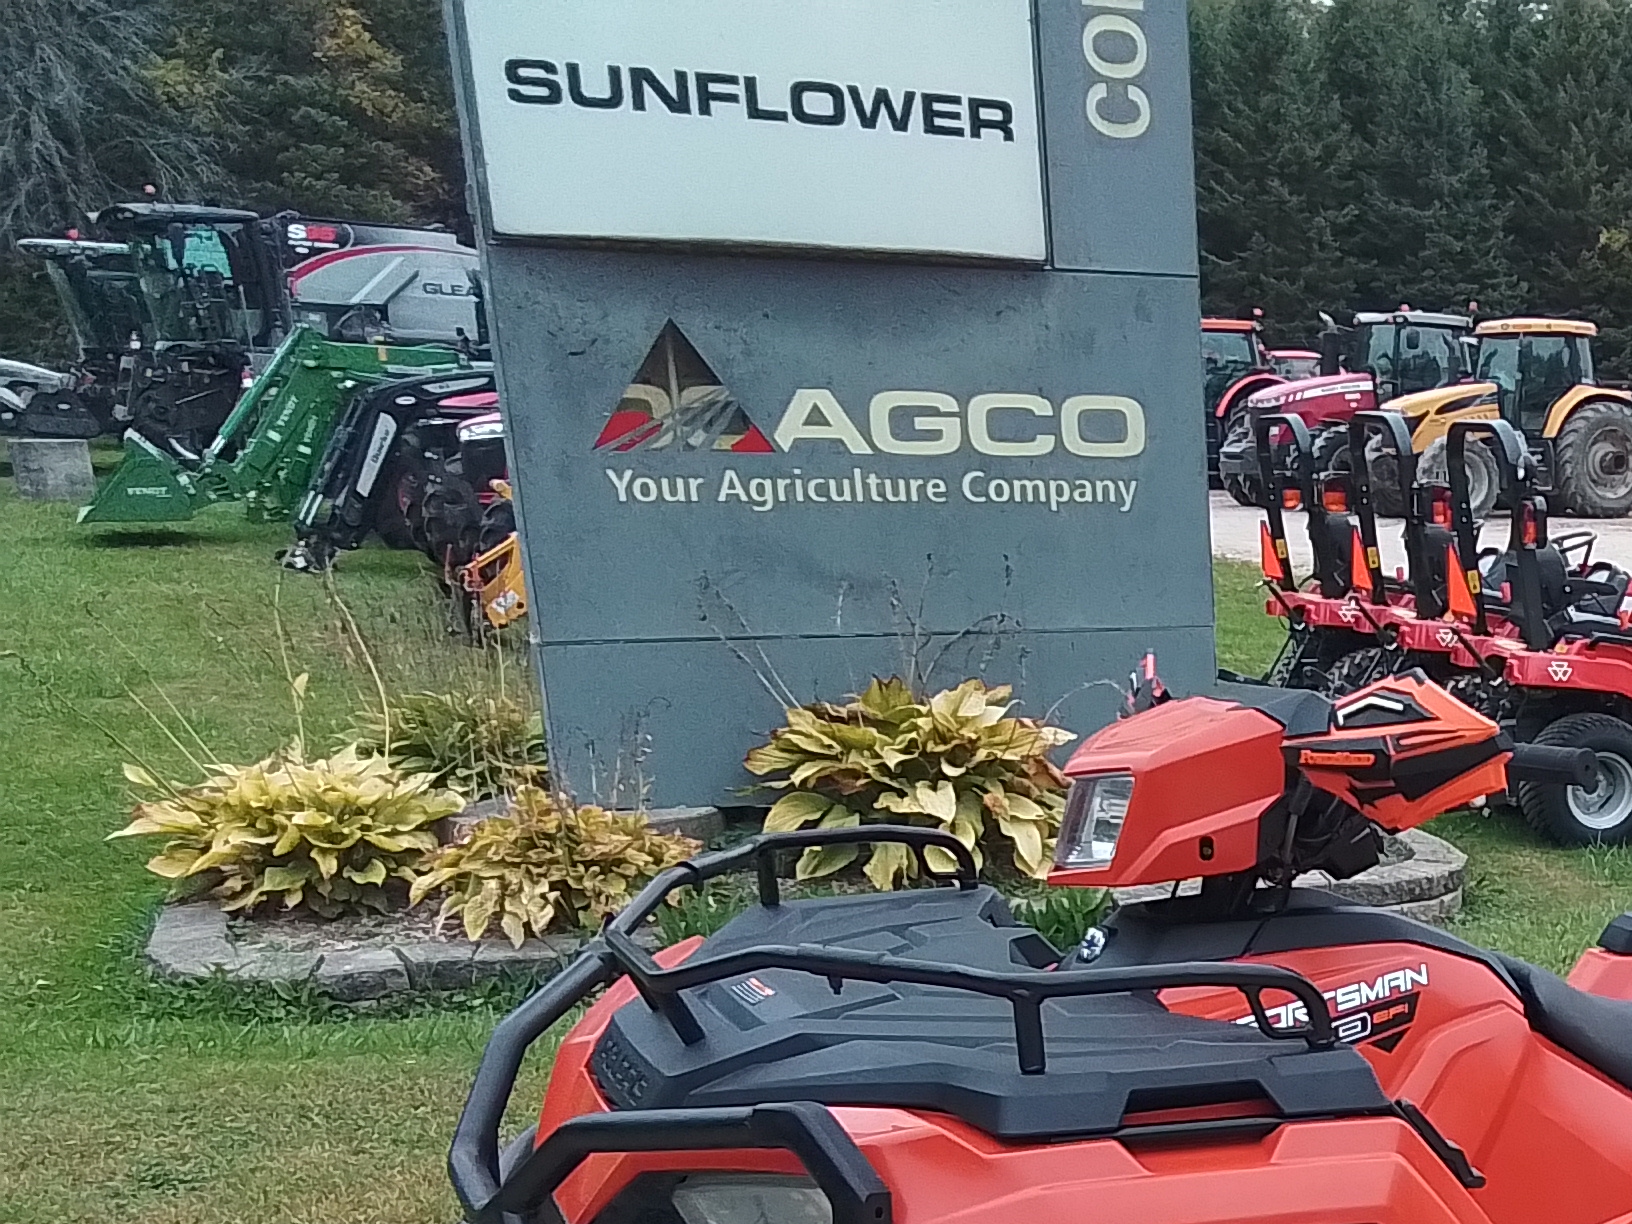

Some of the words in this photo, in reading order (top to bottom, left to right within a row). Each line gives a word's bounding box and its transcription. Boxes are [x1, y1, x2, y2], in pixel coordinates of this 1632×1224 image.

[504, 58, 1015, 143] SUNFLOWER
[1082, 0, 1150, 139] CO
[773, 388, 1146, 458] AGCO
[606, 468, 704, 503] Your
[718, 467, 947, 512] Agriculture
[961, 470, 1137, 512] Company
[1372, 1002, 1409, 1024] EFI
